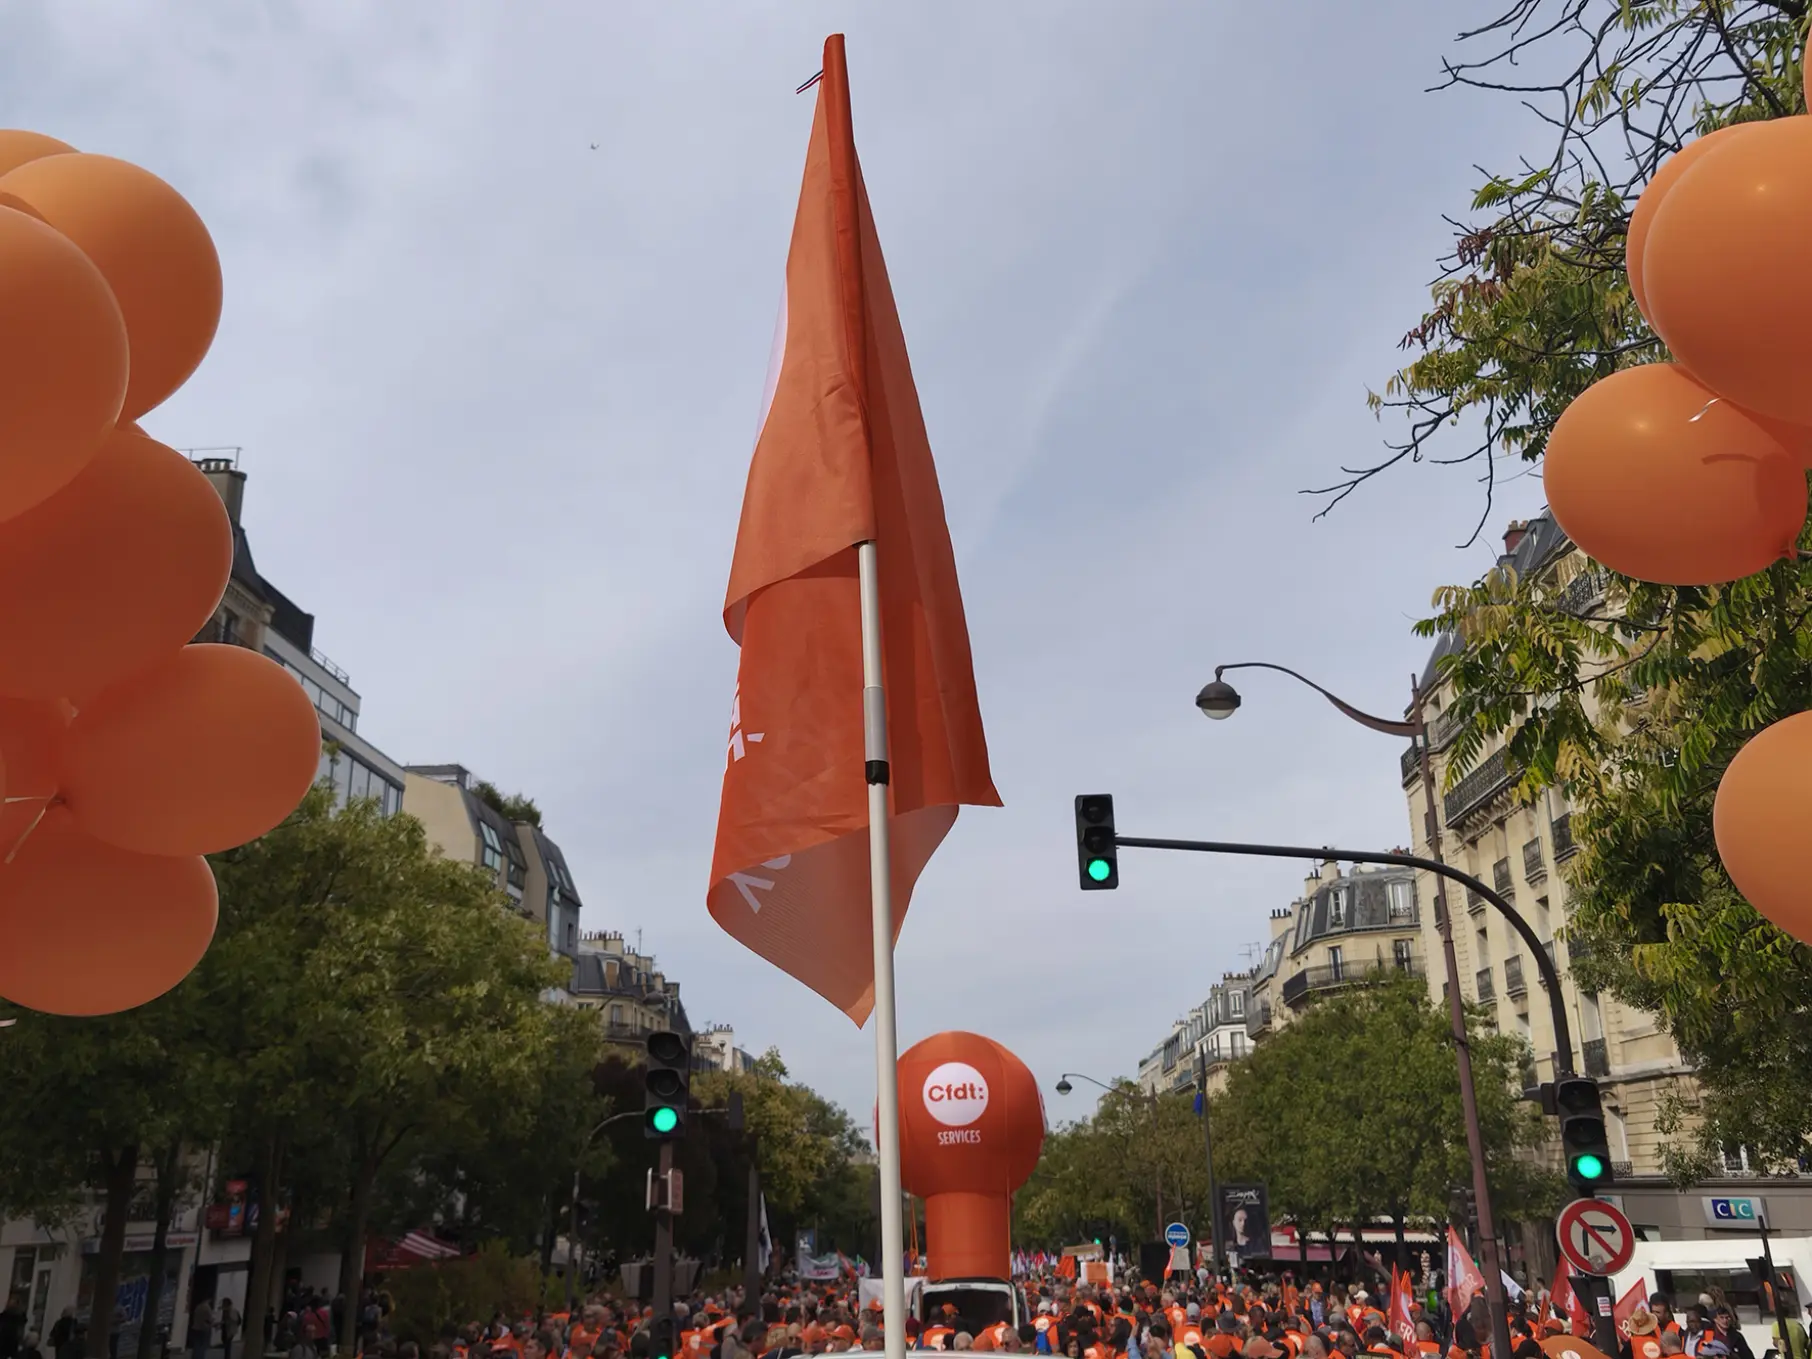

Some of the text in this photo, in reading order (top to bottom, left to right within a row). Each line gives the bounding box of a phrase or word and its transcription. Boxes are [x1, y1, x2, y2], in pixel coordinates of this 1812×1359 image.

[928, 1083, 984, 1102] Cfdt:
[938, 1129, 981, 1146] SERVICES
[1717, 1202, 1751, 1217] CIC
